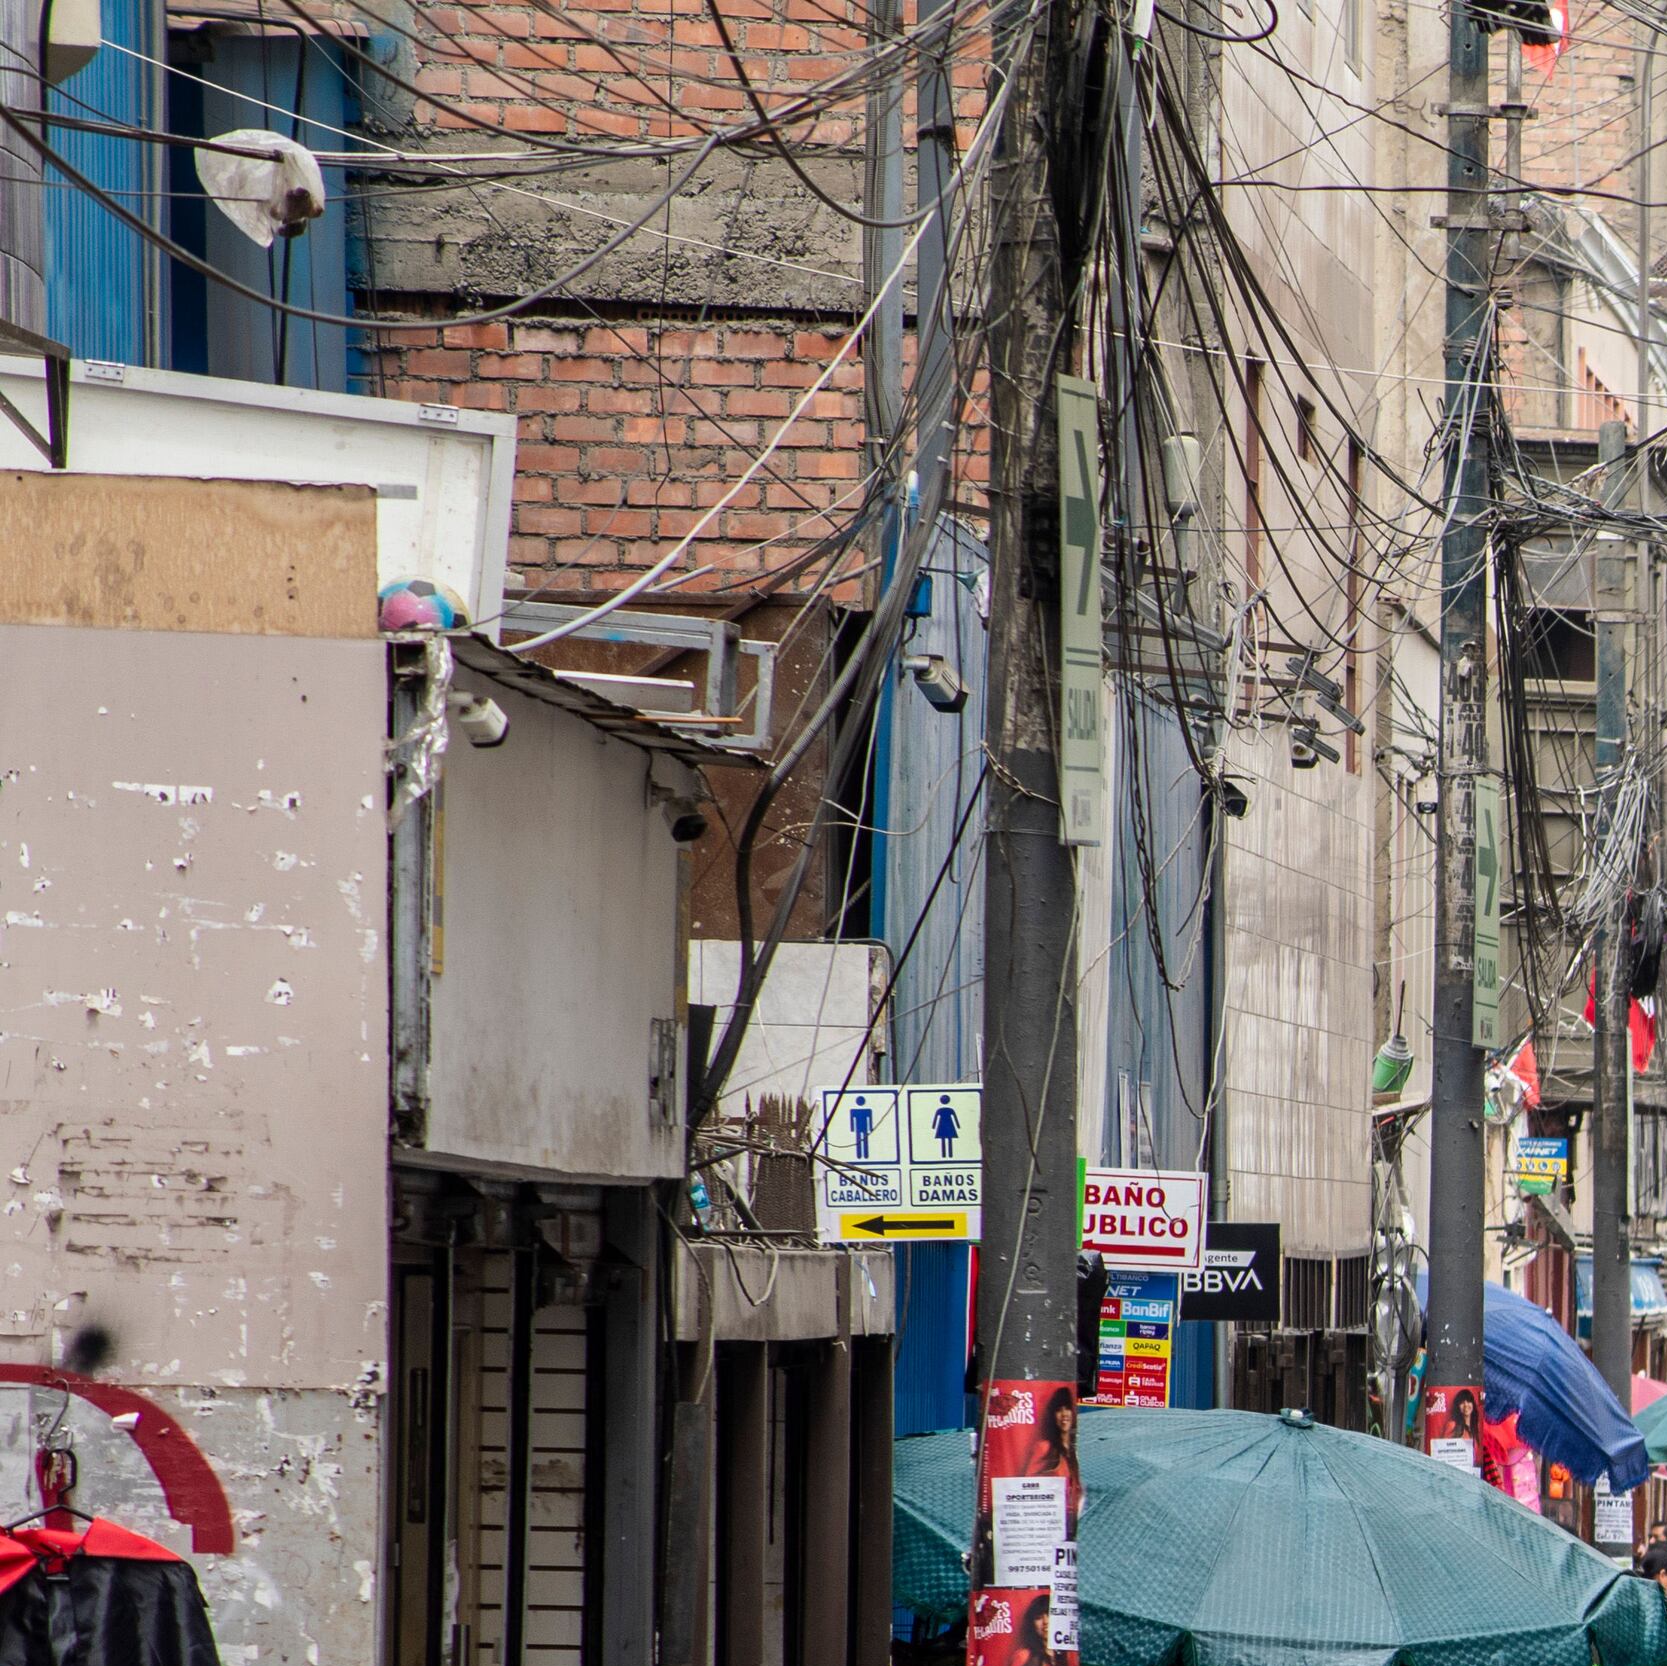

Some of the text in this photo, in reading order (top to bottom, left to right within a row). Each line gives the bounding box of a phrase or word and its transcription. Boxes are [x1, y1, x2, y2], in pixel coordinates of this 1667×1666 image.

[1067, 687, 1097, 741] SALIDA
[1477, 957, 1497, 992] SALIDA
[922, 1172, 975, 1186] BAÑOS
[830, 1188, 898, 1202] CABALLERO
[919, 1189, 978, 1202] DAMAS
[1084, 1181, 1166, 1208] BAÑO
[1083, 1214, 1189, 1239] UBLICO
[1205, 1253, 1239, 1264] gente
[1184, 1268, 1264, 1293] BBVA
[1104, 1285, 1142, 1297] NET
[1121, 1301, 1170, 1318] BanBif
[1132, 1343, 1161, 1351] QAPAQ
